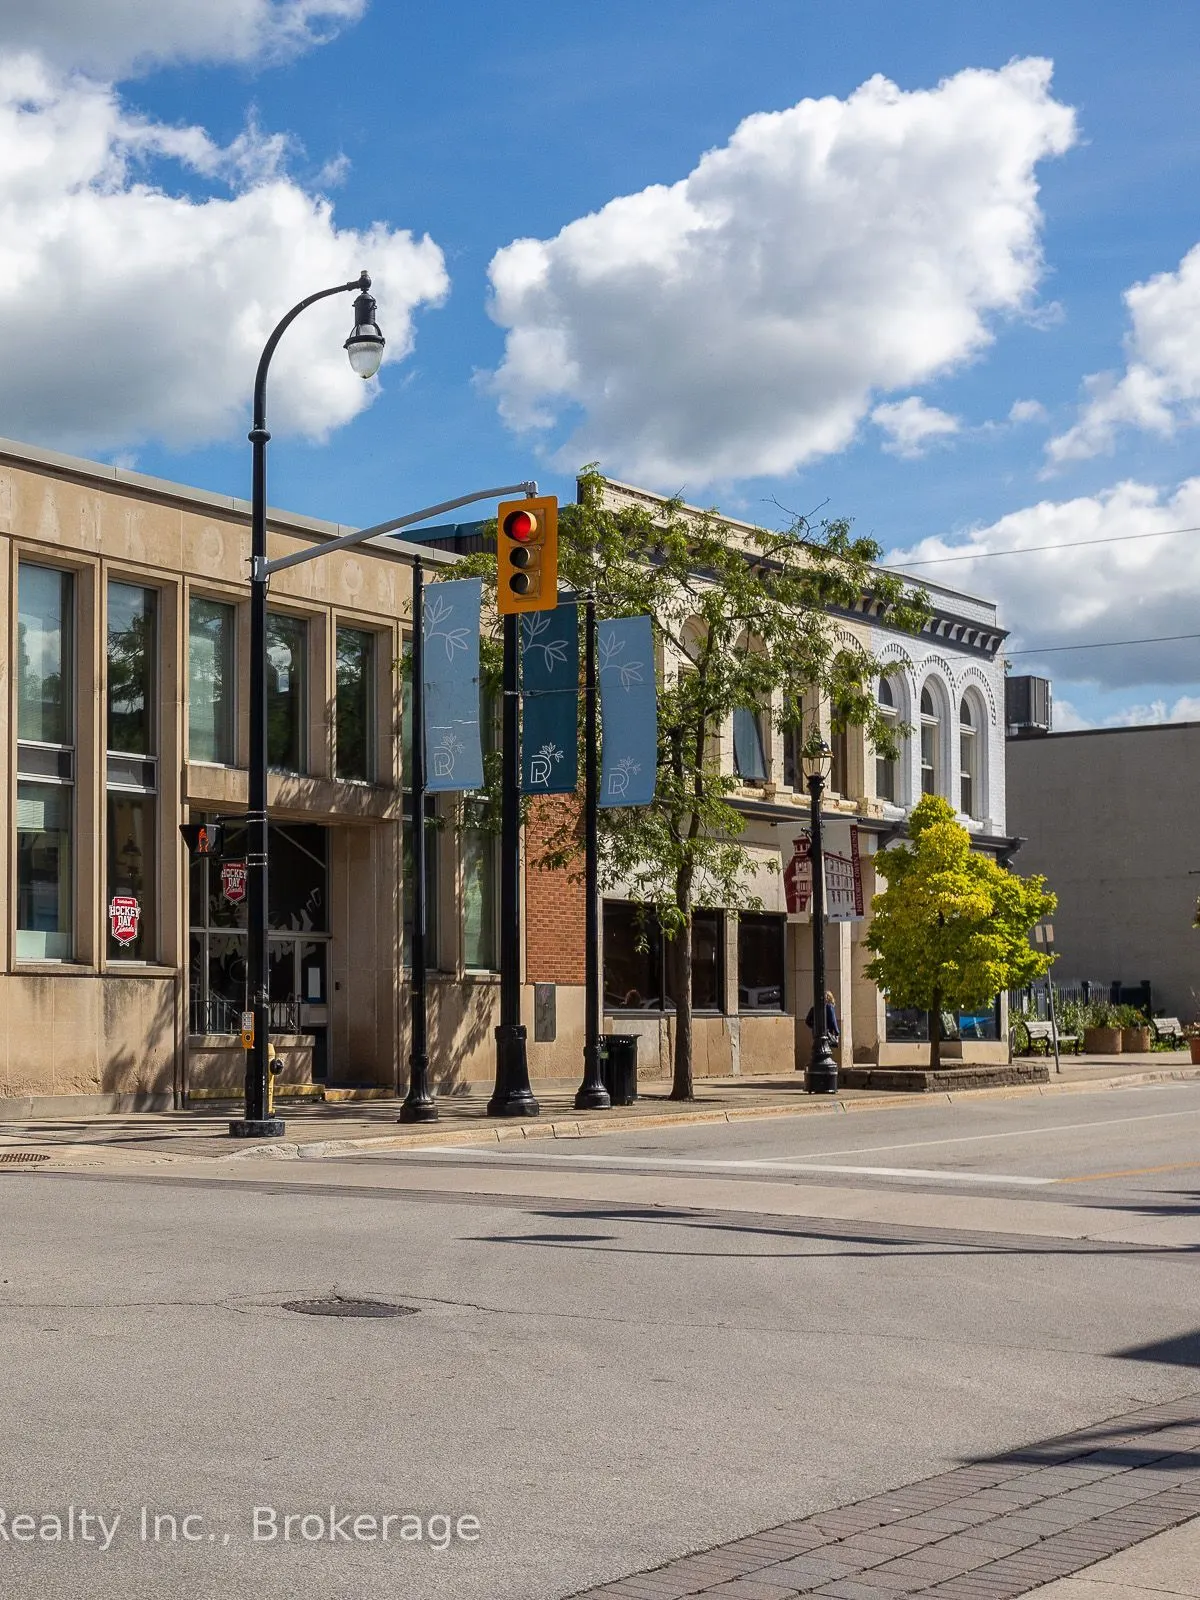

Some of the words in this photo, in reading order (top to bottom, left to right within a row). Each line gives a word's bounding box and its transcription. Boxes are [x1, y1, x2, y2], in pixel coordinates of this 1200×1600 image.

[851, 829, 859, 855] SOUND
[221, 869, 247, 881] HOCKEY
[228, 877, 241, 888] DAY
[109, 904, 141, 920] HOCKEY
[117, 915, 133, 927] DAY
